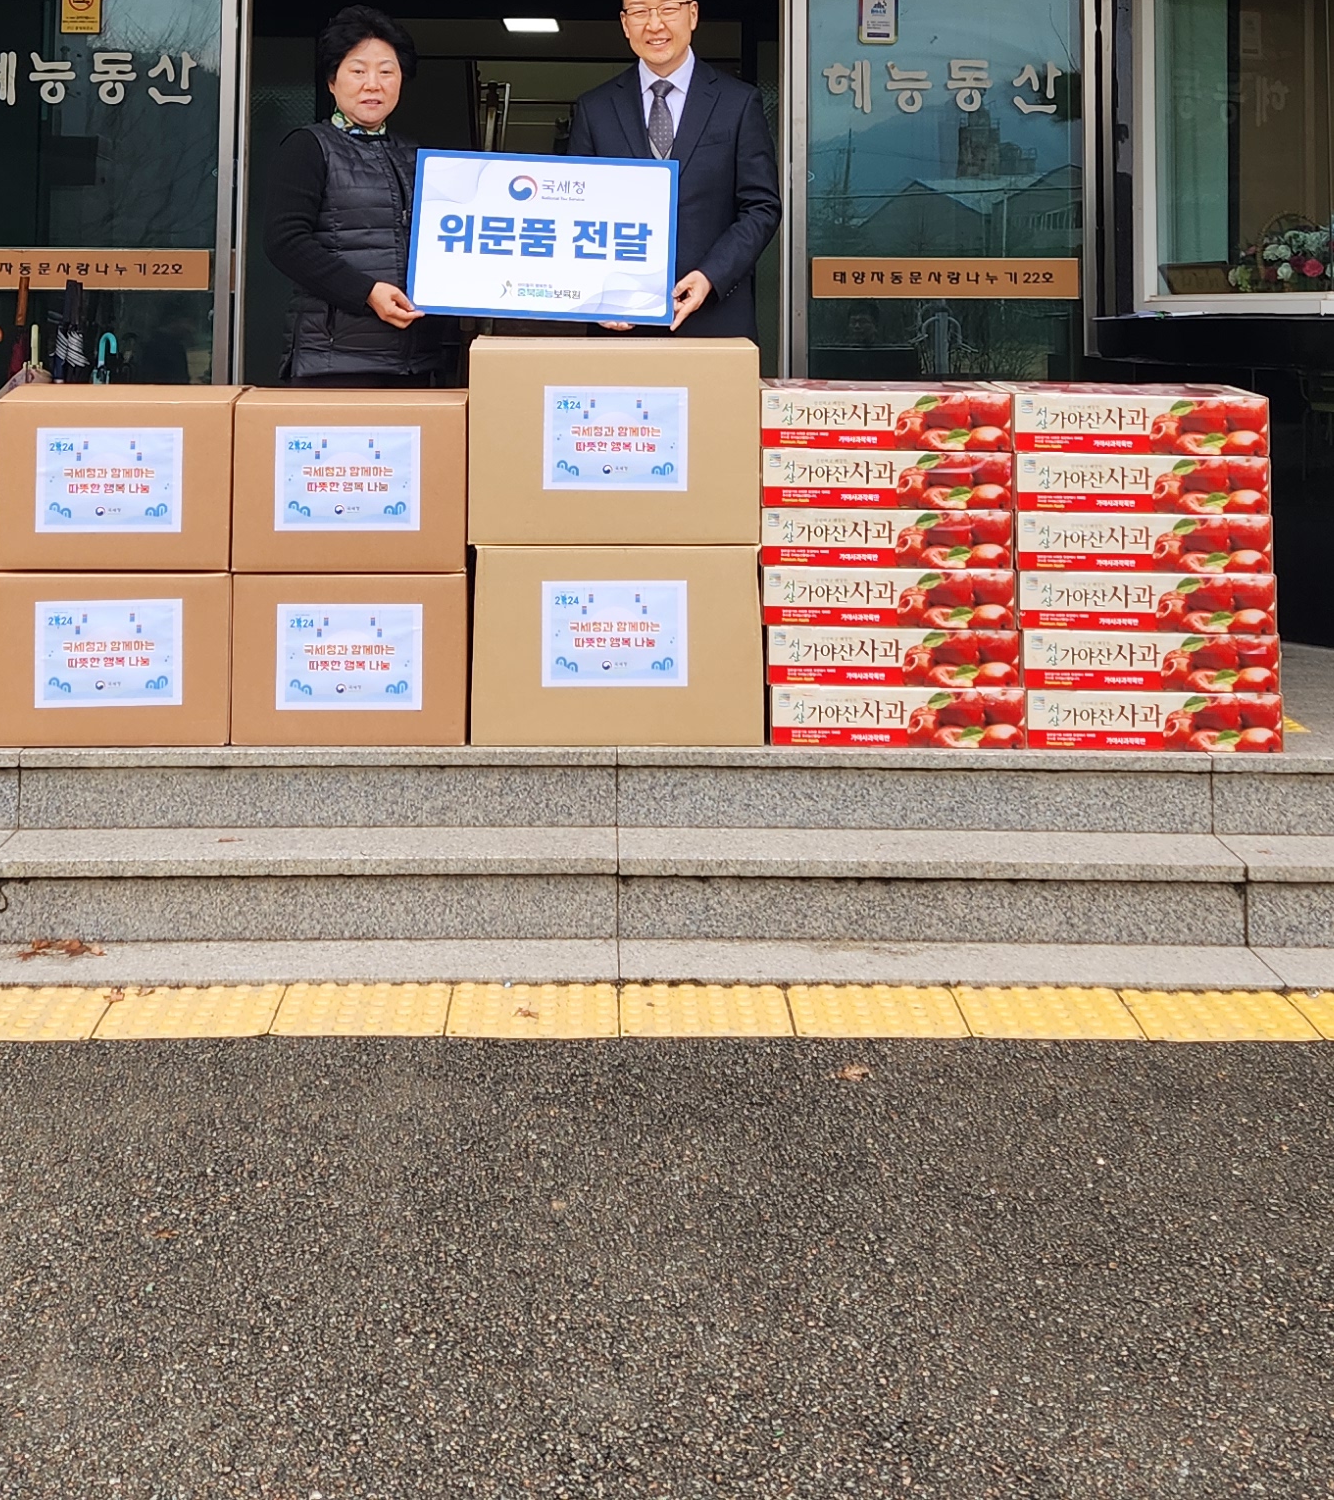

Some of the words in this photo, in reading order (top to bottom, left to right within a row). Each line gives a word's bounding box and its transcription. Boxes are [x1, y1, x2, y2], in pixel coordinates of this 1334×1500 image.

[822, 59, 1062, 114] 혜능동산
[542, 179, 585, 194] 국세청
[438, 214, 556, 257] 위문품
[572, 219, 653, 262] 전달
[557, 400, 581, 410] 224
[571, 426, 614, 436] 국세청과
[617, 426, 661, 436] 함께하는
[49, 442, 73, 451] 224
[289, 440, 312, 450] 224
[576, 442, 607, 452] 따뜻한
[611, 442, 632, 452] 행복
[636, 442, 655, 452] 나눔
[64, 468, 107, 478] 국세청과
[111, 468, 155, 478] 함께하는
[303, 466, 346, 476] 국세청과
[349, 466, 393, 476] 함께하는
[69, 484, 101, 494] 따뜻한
[104, 484, 125, 493] 행복
[129, 484, 149, 493] 나눔
[307, 482, 339, 492] 따뜻한
[343, 482, 363, 492] 행복
[368, 482, 388, 492] 나눔
[555, 595, 579, 605] 224
[48, 616, 72, 625] 224
[290, 618, 313, 628] 224
[570, 622, 613, 632] 국세청과
[617, 622, 660, 632] 함께하는
[63, 642, 107, 652] 국세청과
[111, 641, 155, 651] 함께하는
[575, 638, 606, 648] 따뜻한
[610, 637, 631, 648] 행복
[635, 637, 655, 648] 나눔
[304, 645, 348, 655] 국세청과
[351, 645, 395, 655] 함께하는
[68, 658, 100, 668] 따뜻한
[103, 657, 125, 667] 행복
[129, 656, 149, 666] 나눔
[309, 660, 341, 670] 따뜻한
[344, 660, 365, 670] 행복
[369, 660, 390, 670] 나눔
